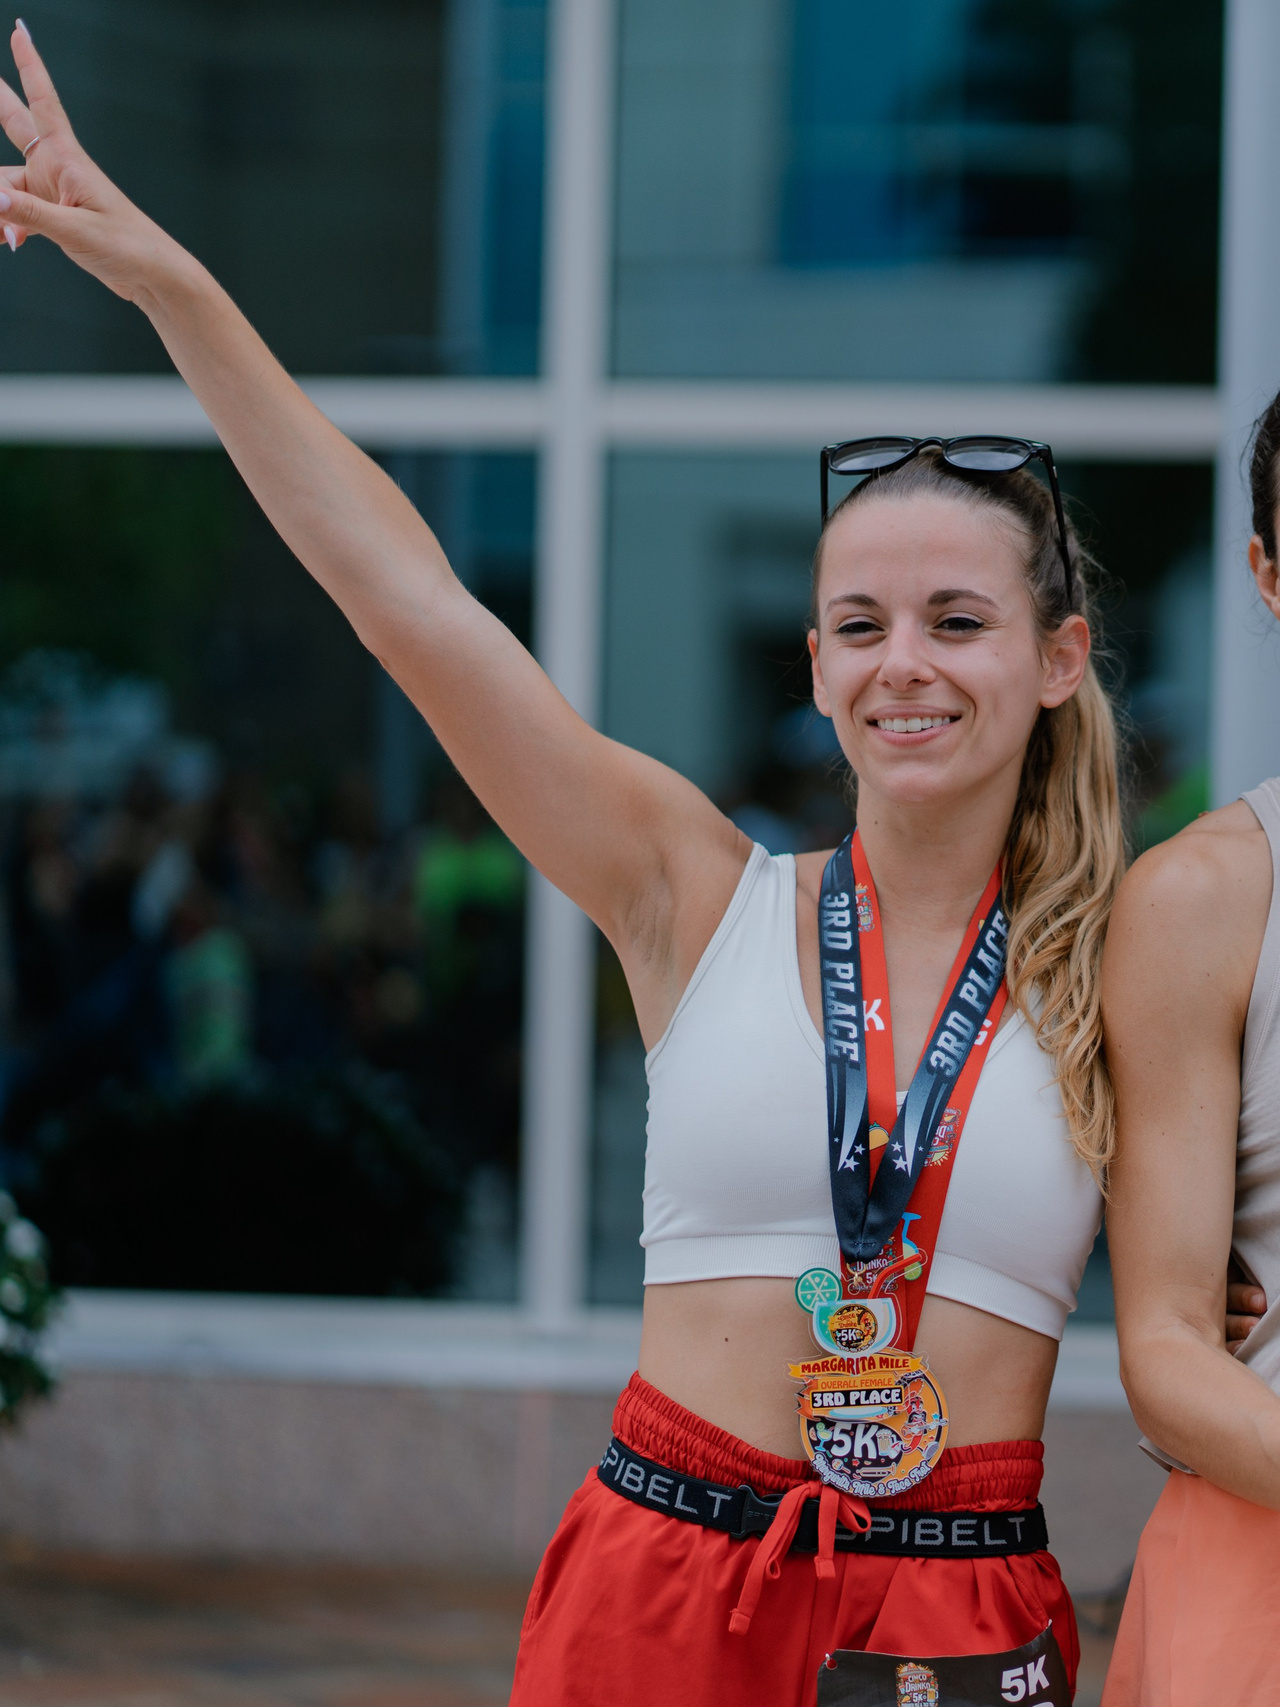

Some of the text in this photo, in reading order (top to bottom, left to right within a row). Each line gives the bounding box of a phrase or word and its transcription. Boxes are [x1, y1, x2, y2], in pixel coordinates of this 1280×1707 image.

[822, 892, 860, 1063] 3RD PLACE
[929, 1010, 977, 1077] 3RD
[841, 1329, 857, 1341] 5K
[801, 1355, 910, 1376] MARGARITA MILE
[820, 1377, 894, 1390] OVERALL FEMALE
[812, 1388, 902, 1408] 3RD PLACE
[830, 1422, 879, 1460] 5K
[852, 1480, 876, 1496] Mile
[1000, 1653, 1051, 1703] 5K
